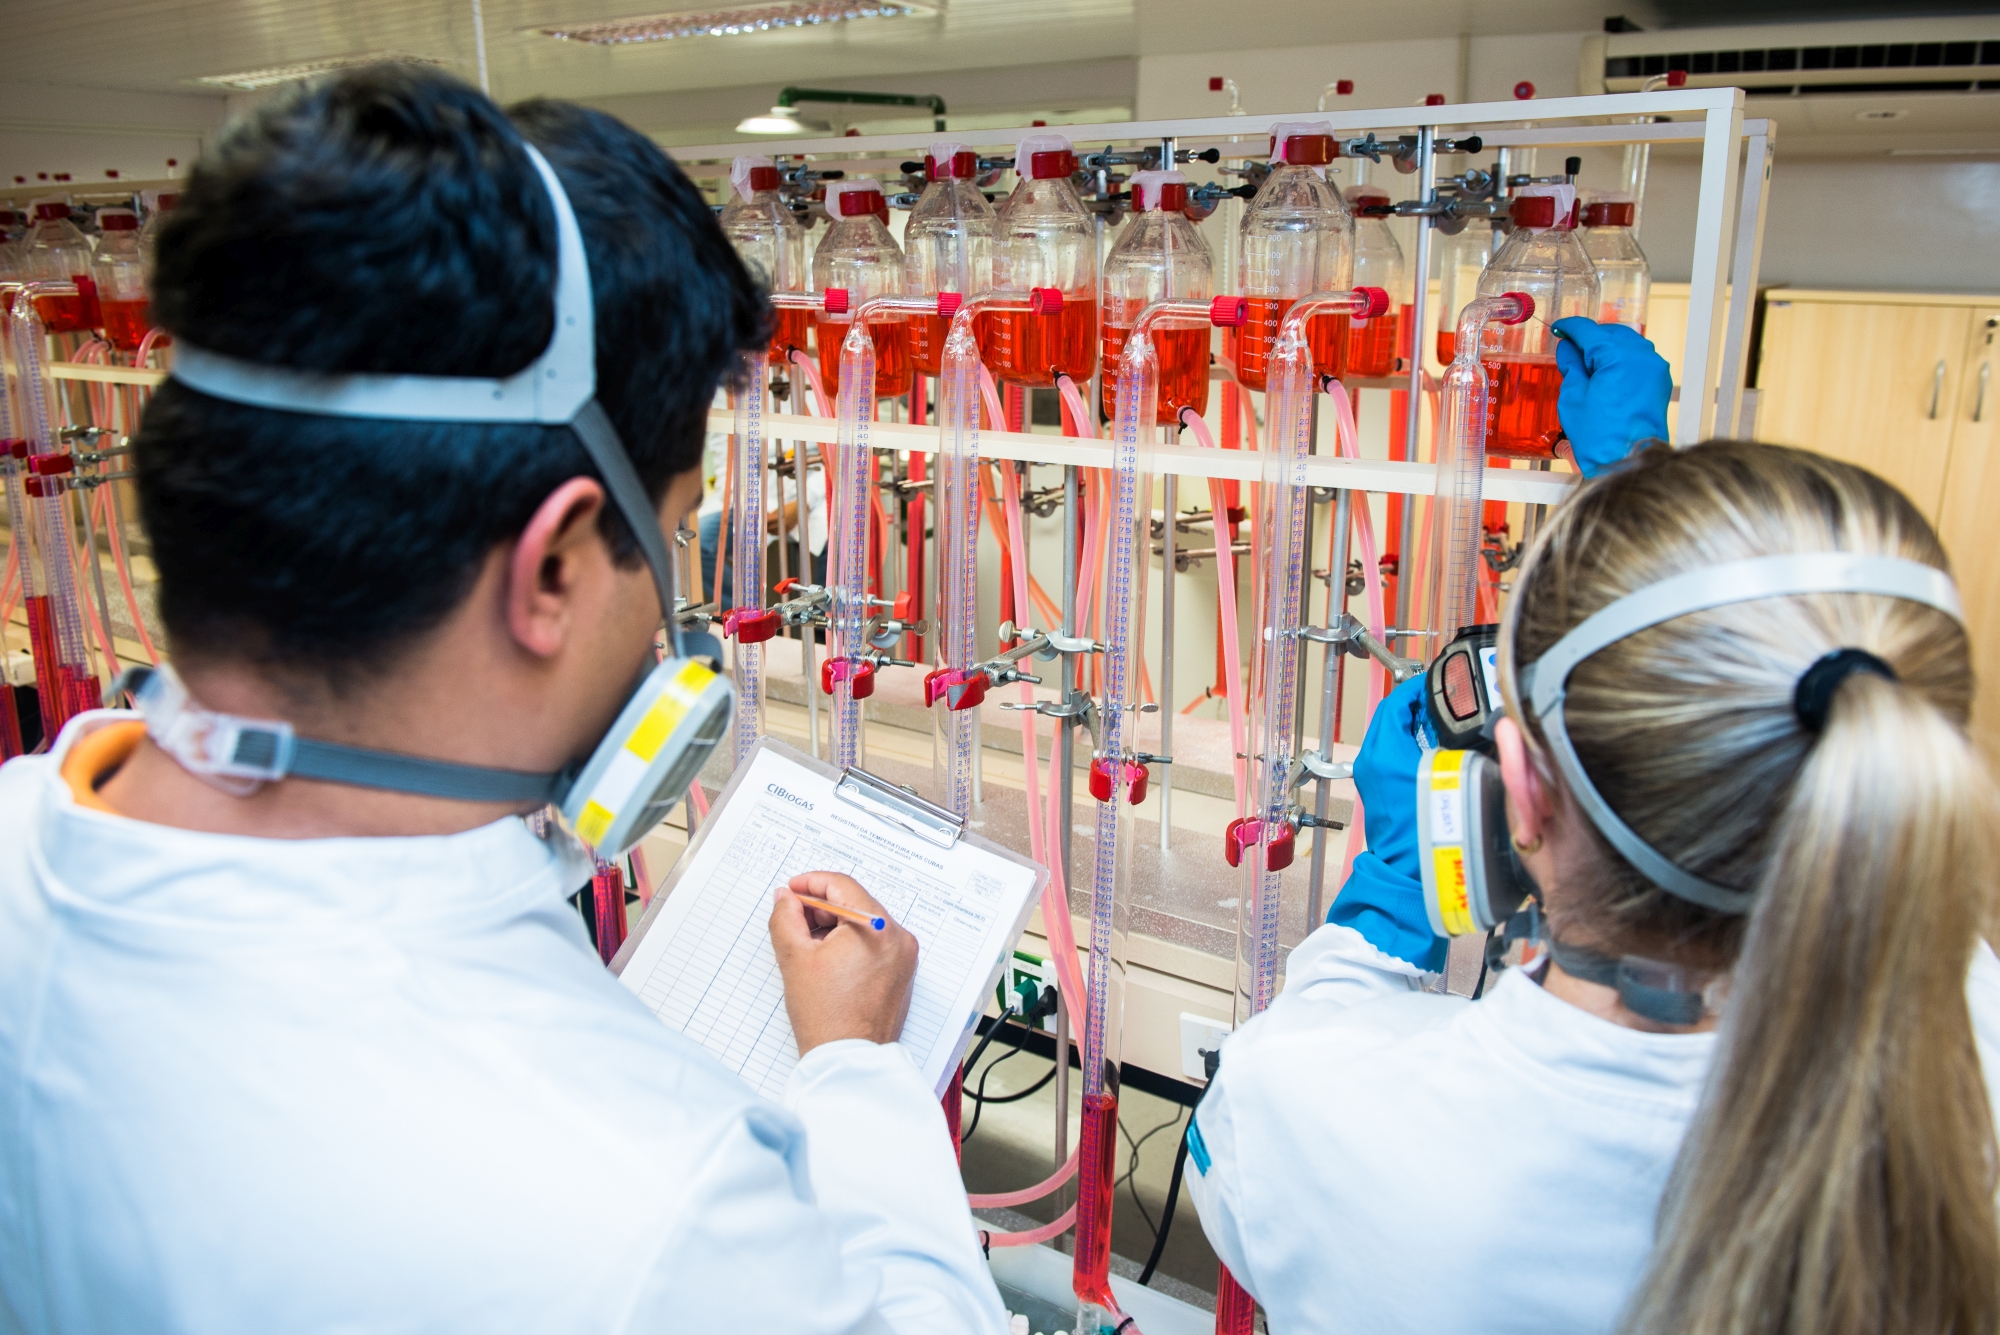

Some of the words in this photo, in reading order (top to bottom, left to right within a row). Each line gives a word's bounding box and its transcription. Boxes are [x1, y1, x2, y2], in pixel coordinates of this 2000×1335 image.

[1488, 362, 1501, 370] 500
[760, 812, 785, 827] Temperatura
[830, 813, 859, 830] REGISTRO
[868, 831, 910, 854] TEMPERATURA
[910, 851, 923, 860] DAS
[923, 857, 943, 869] CUBAS
[1097, 866, 1113, 874] 255
[878, 868, 905, 884] Temperatura
[915, 877, 933, 888] Número
[939, 888, 951, 896] cuba
[1096, 884, 1112, 892] 265
[1095, 902, 1111, 910] 275
[1094, 910, 1110, 918] 280
[952, 916, 981, 933] Observações
[1094, 919, 1110, 927] 285
[1093, 927, 1109, 935] 290
[1093, 936, 1109, 944] 295
